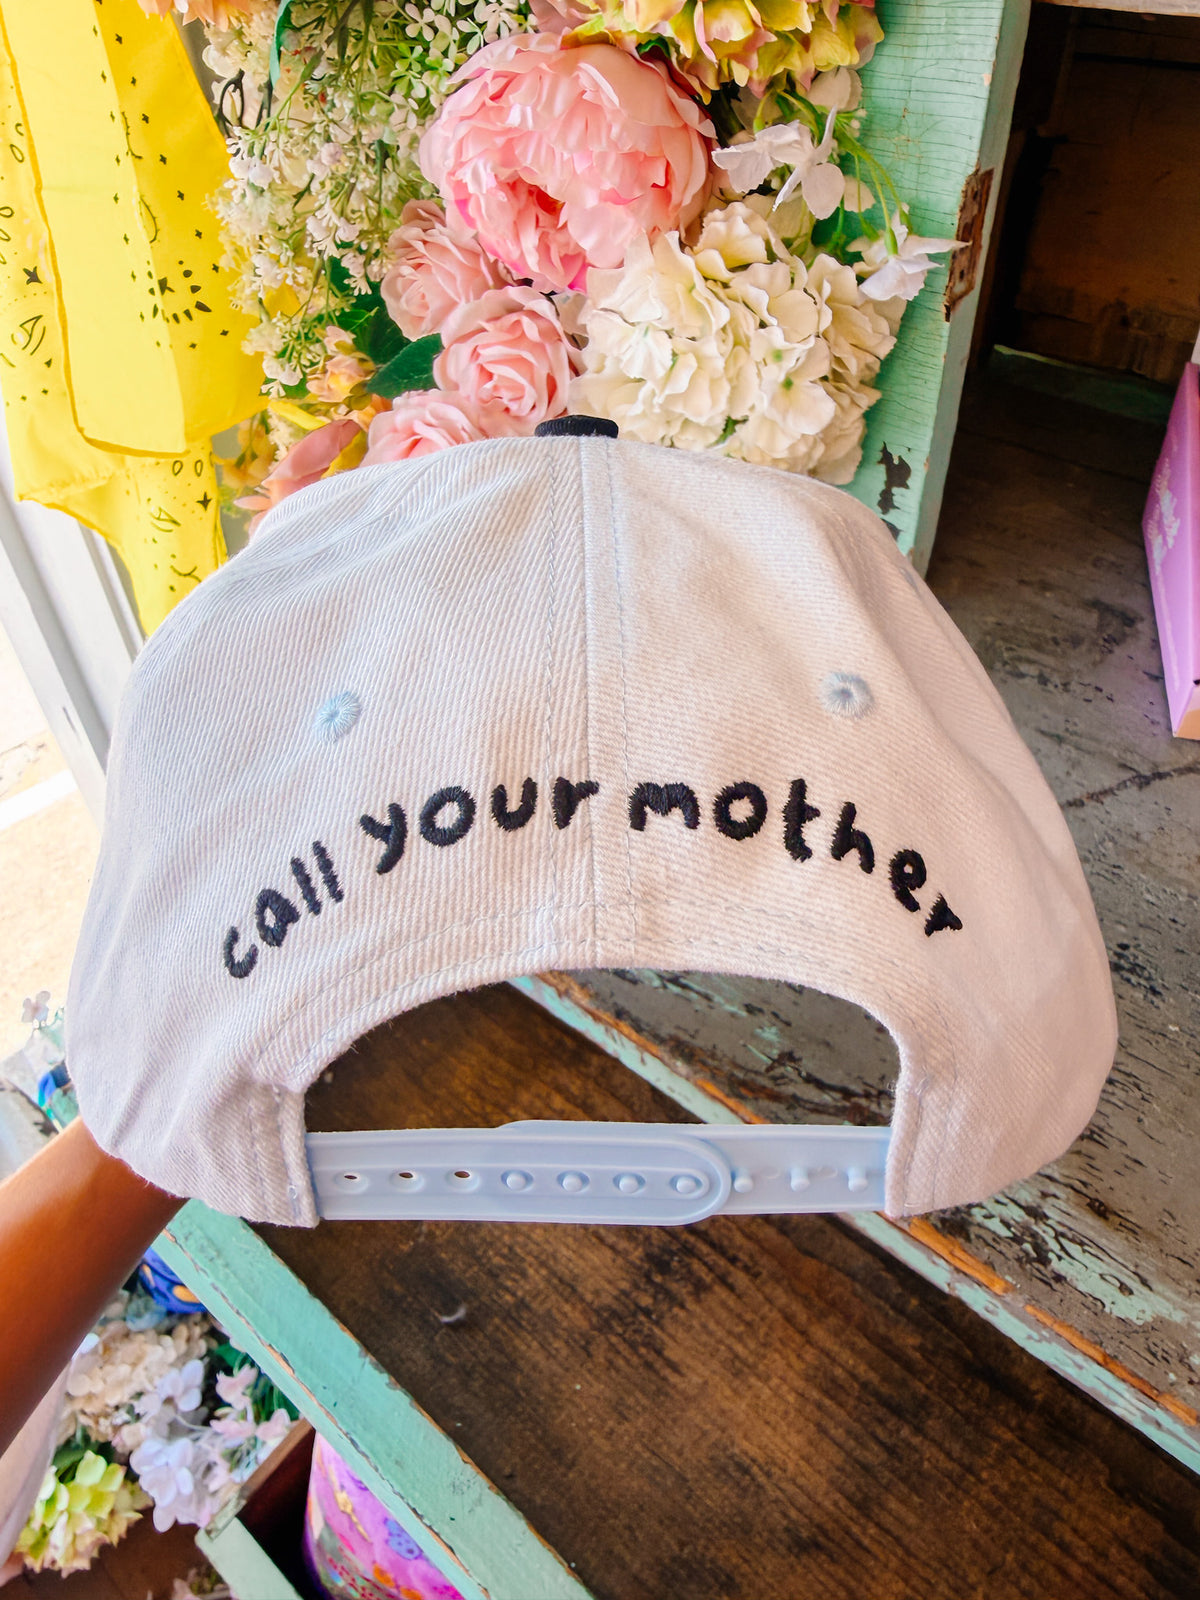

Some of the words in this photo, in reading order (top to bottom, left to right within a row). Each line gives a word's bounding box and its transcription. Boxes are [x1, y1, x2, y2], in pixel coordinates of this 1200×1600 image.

[223, 840, 345, 979] call
[359, 776, 600, 876] your
[627, 777, 964, 939] mother
